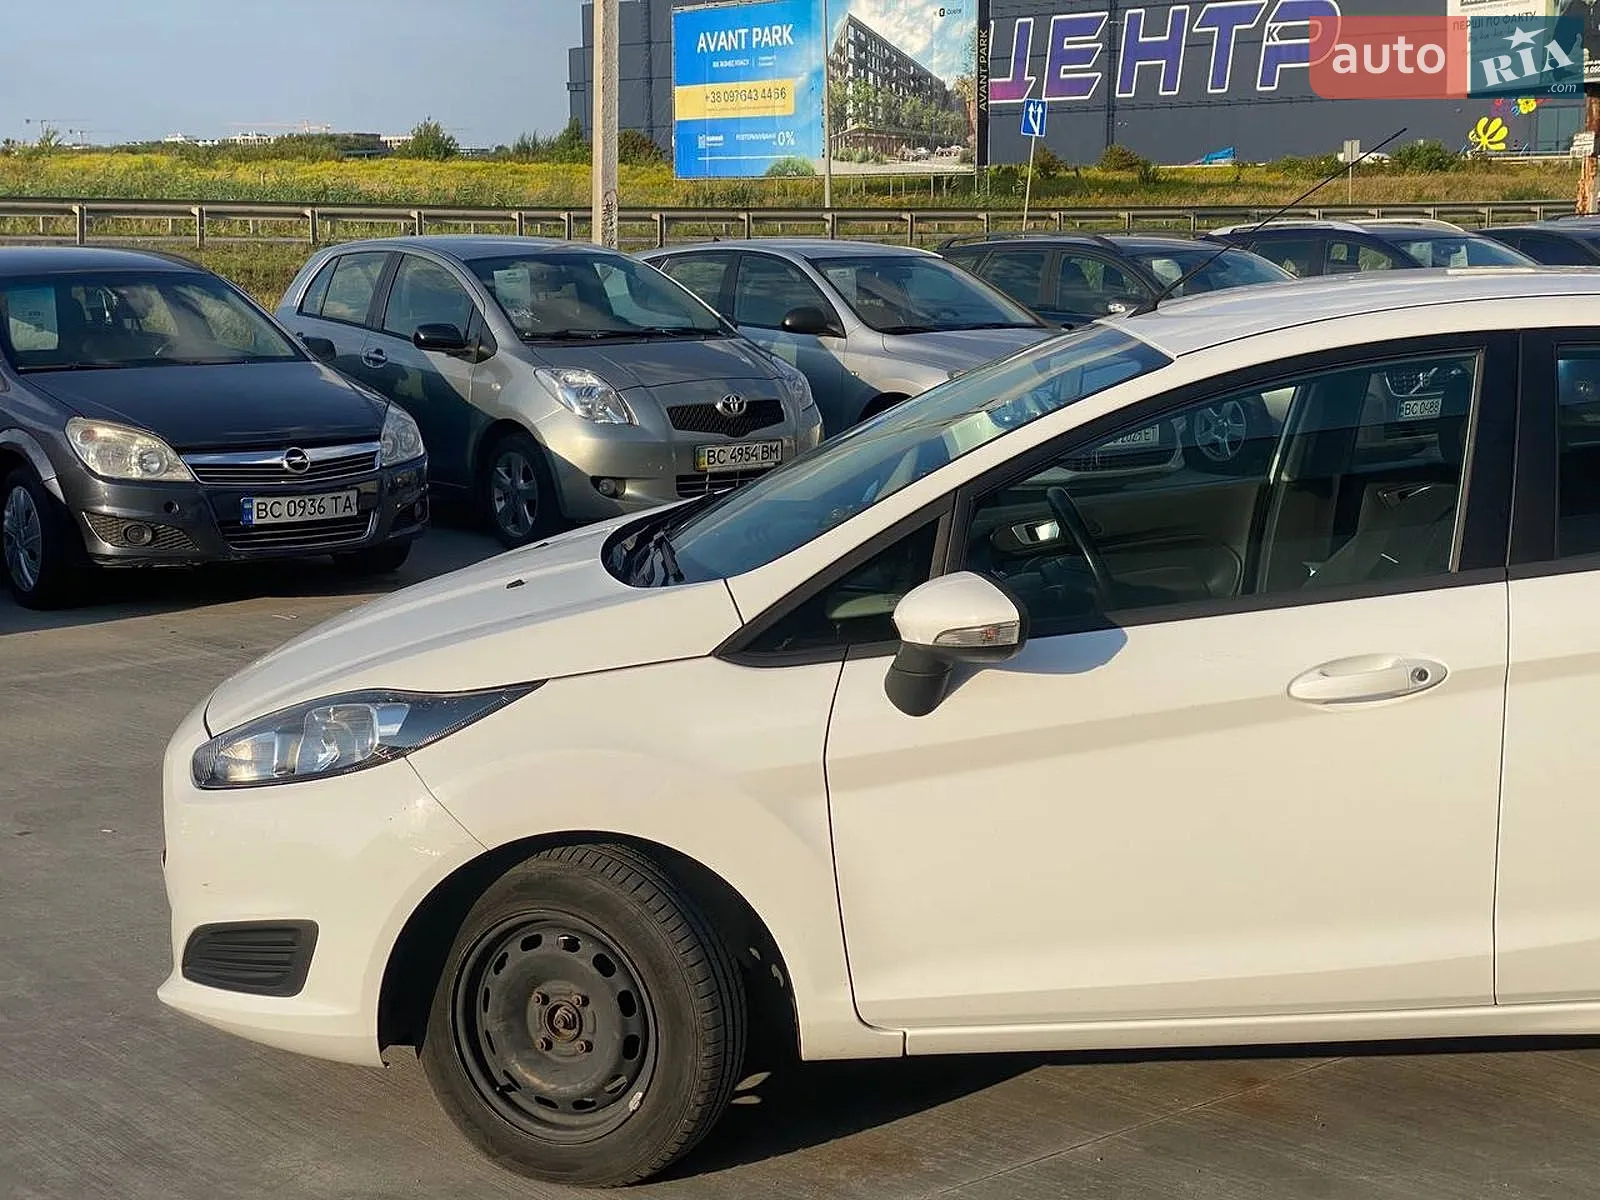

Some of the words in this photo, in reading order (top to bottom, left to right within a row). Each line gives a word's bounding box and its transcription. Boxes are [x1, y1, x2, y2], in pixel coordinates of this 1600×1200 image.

[697, 28, 749, 54] AVANT
[752, 23, 794, 49] PARK
[979, 29, 989, 64] PARK
[979, 66, 989, 111] AVANT
[777, 130, 795, 147] 0%
[707, 449, 727, 465] BC
[729, 444, 759, 463] 4954
[761, 442, 779, 461] BM
[256, 501, 282, 520] BC
[286, 496, 326, 517] 0936
[330, 495, 353, 515] TA
